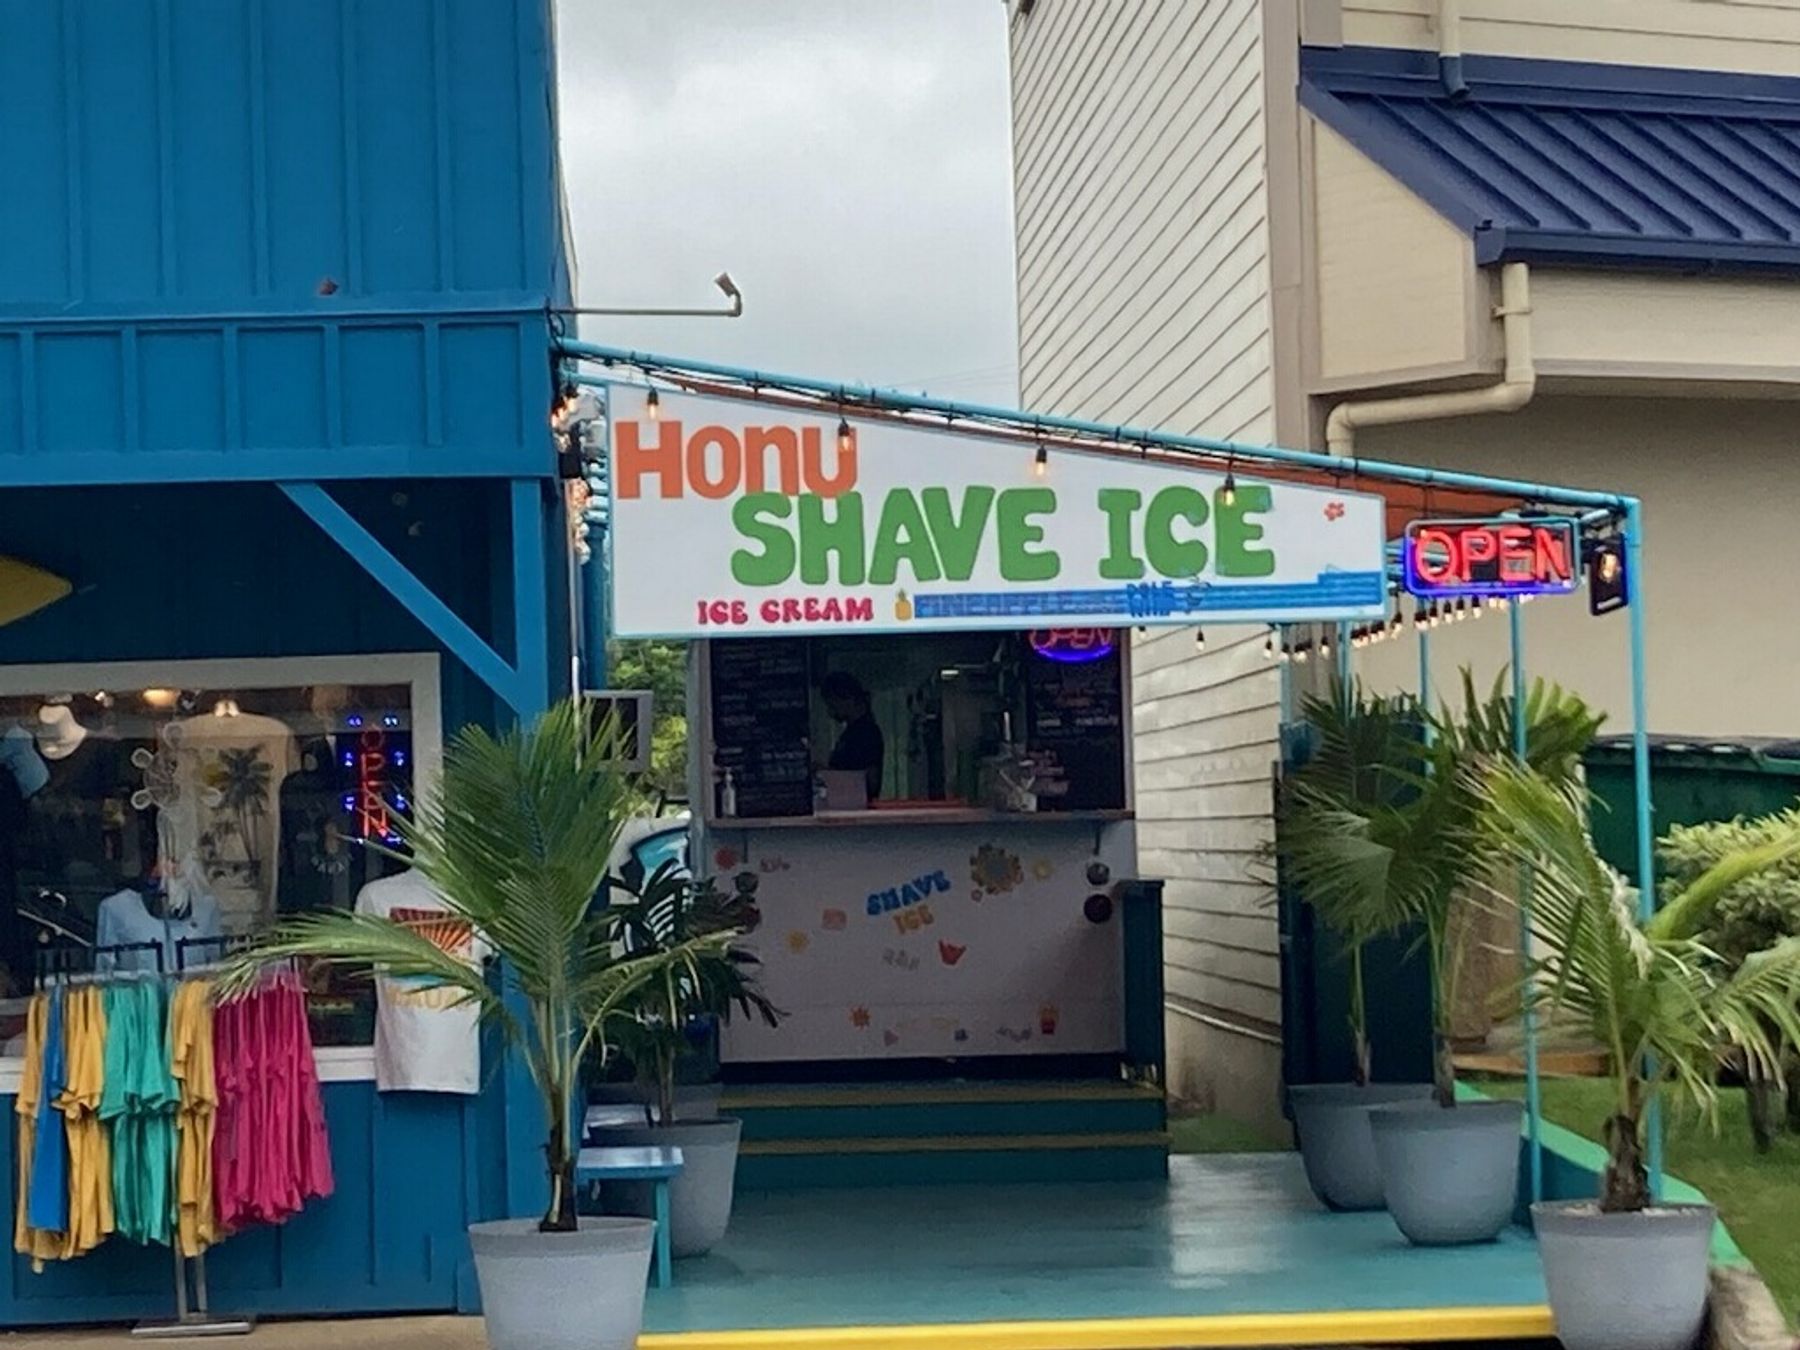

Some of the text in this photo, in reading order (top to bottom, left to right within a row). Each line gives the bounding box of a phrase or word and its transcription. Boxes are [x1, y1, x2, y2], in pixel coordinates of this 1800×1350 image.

[731, 485, 1276, 587] SHAVE ICE
[1415, 526, 1570, 582] OPEN
[697, 596, 875, 626] ICE CREAM
[866, 870, 951, 915] SHAVE
[893, 905, 934, 935] ICE
